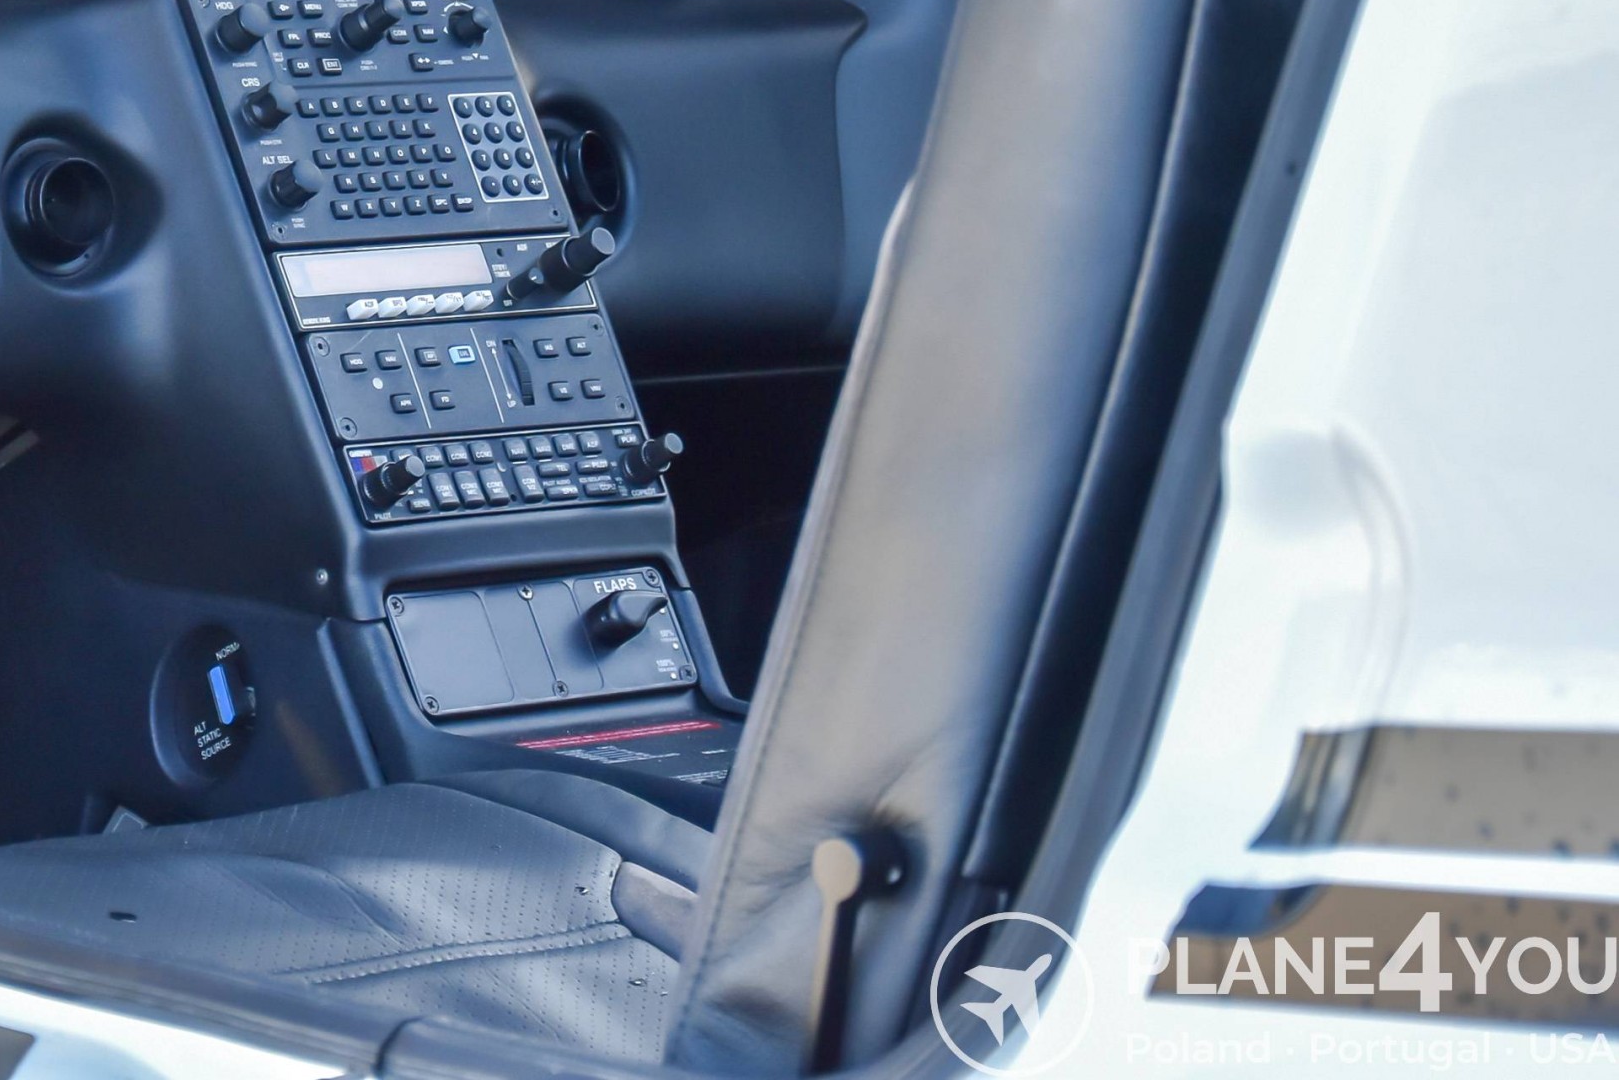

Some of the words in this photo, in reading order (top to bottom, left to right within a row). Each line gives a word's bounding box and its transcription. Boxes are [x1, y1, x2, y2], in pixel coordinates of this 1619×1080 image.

[215, 1, 234, 10] HDG
[304, 3, 322, 11] MENU
[288, 33, 300, 41] FPL
[241, 77, 260, 87] CRS
[308, 102, 314, 110] A
[332, 101, 339, 109] B
[380, 99, 387, 107] D
[403, 98, 410, 106] E
[485, 100, 491, 108] 2
[423, 122, 430, 130] K
[472, 128, 478, 136] 4
[494, 126, 500, 134] 5
[515, 125, 522, 134] 6
[262, 155, 276, 165] ALT
[277, 155, 294, 164] SEL
[525, 152, 531, 160] 9
[370, 176, 377, 184] S
[418, 174, 425, 182] U
[390, 201, 397, 209] Y
[506, 400, 516, 408] UP
[561, 443, 576, 451] DME
[586, 440, 599, 448] ADF
[556, 464, 569, 472] TEL
[593, 577, 637, 593] FLAPS
[193, 721, 207, 735] ALT
[197, 727, 222, 748] STATIC
[200, 736, 232, 760] SOURCE
